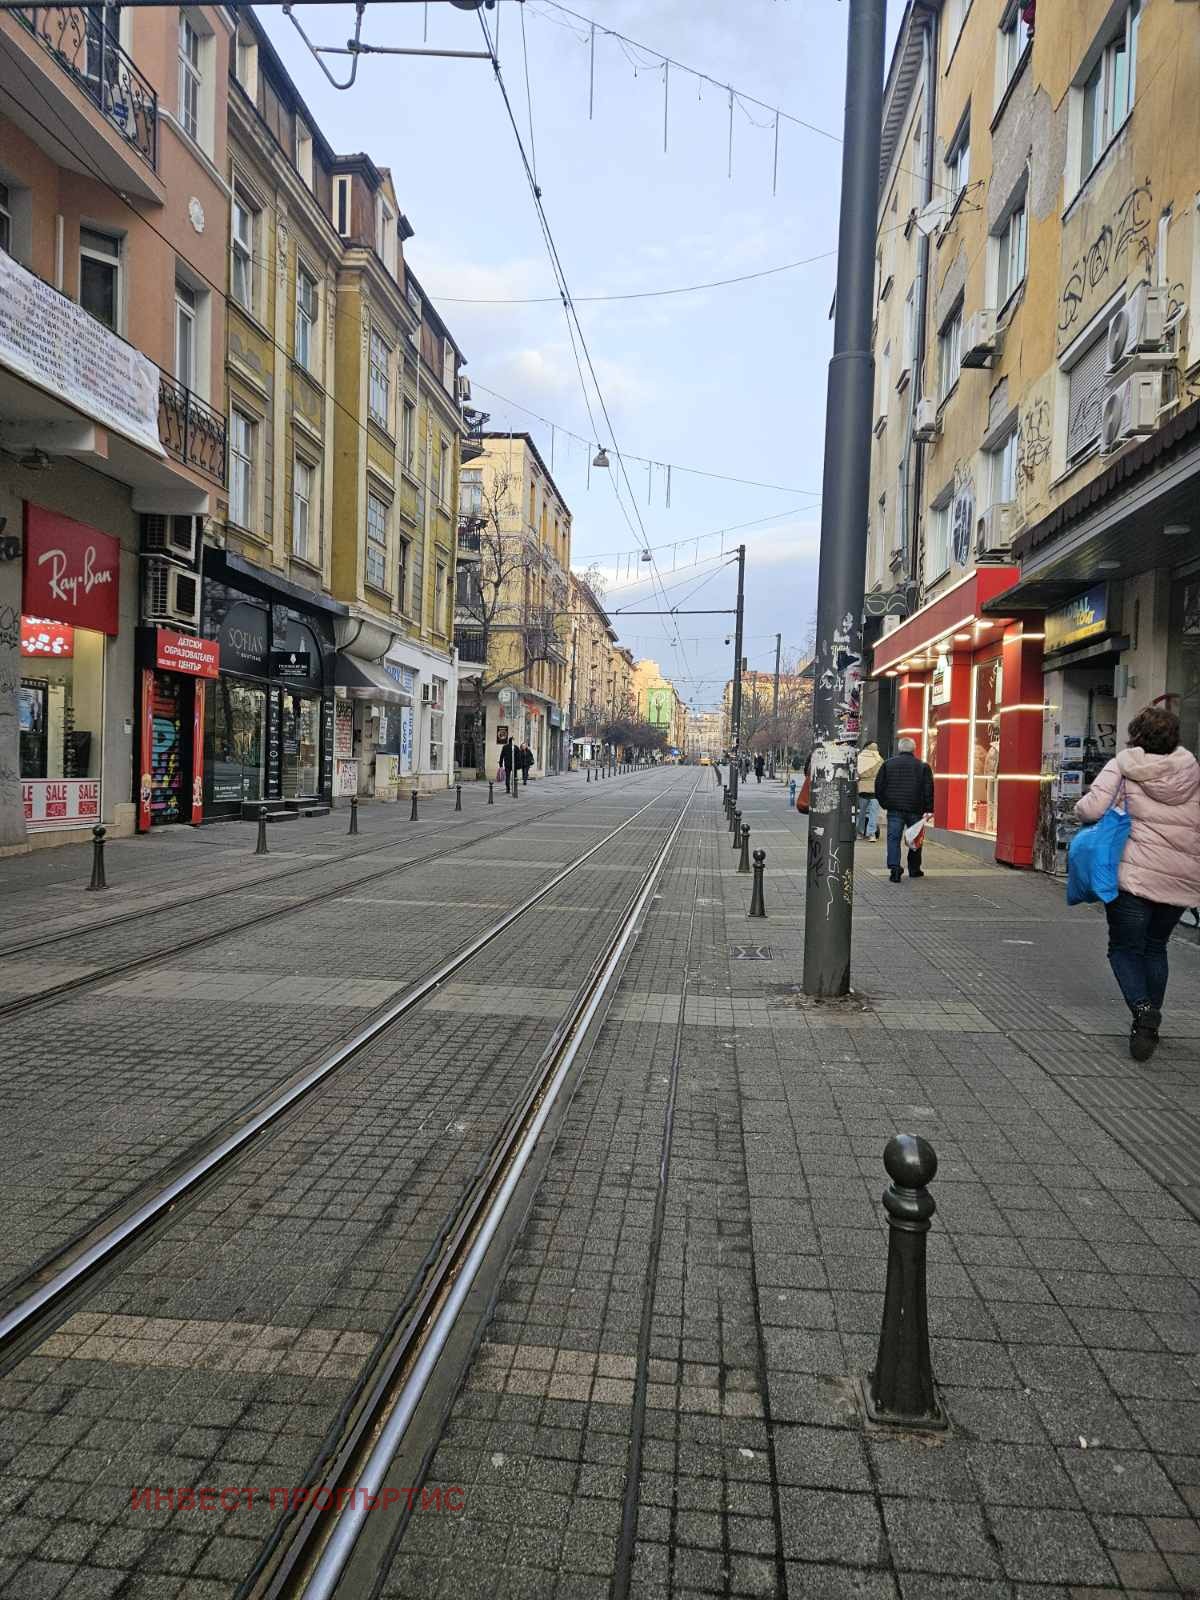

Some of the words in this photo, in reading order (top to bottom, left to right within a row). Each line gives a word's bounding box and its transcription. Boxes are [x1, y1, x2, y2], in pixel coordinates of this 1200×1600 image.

[178, 637, 202, 650] ДЕТСКИ
[164, 645, 215, 663] ОБРАЗОВАТЕЛЕН
[178, 659, 202, 671] ЦЕНТЪР
[22, 785, 33, 801] LE
[46, 785, 67, 801] SALE
[79, 784, 98, 799] SALE
